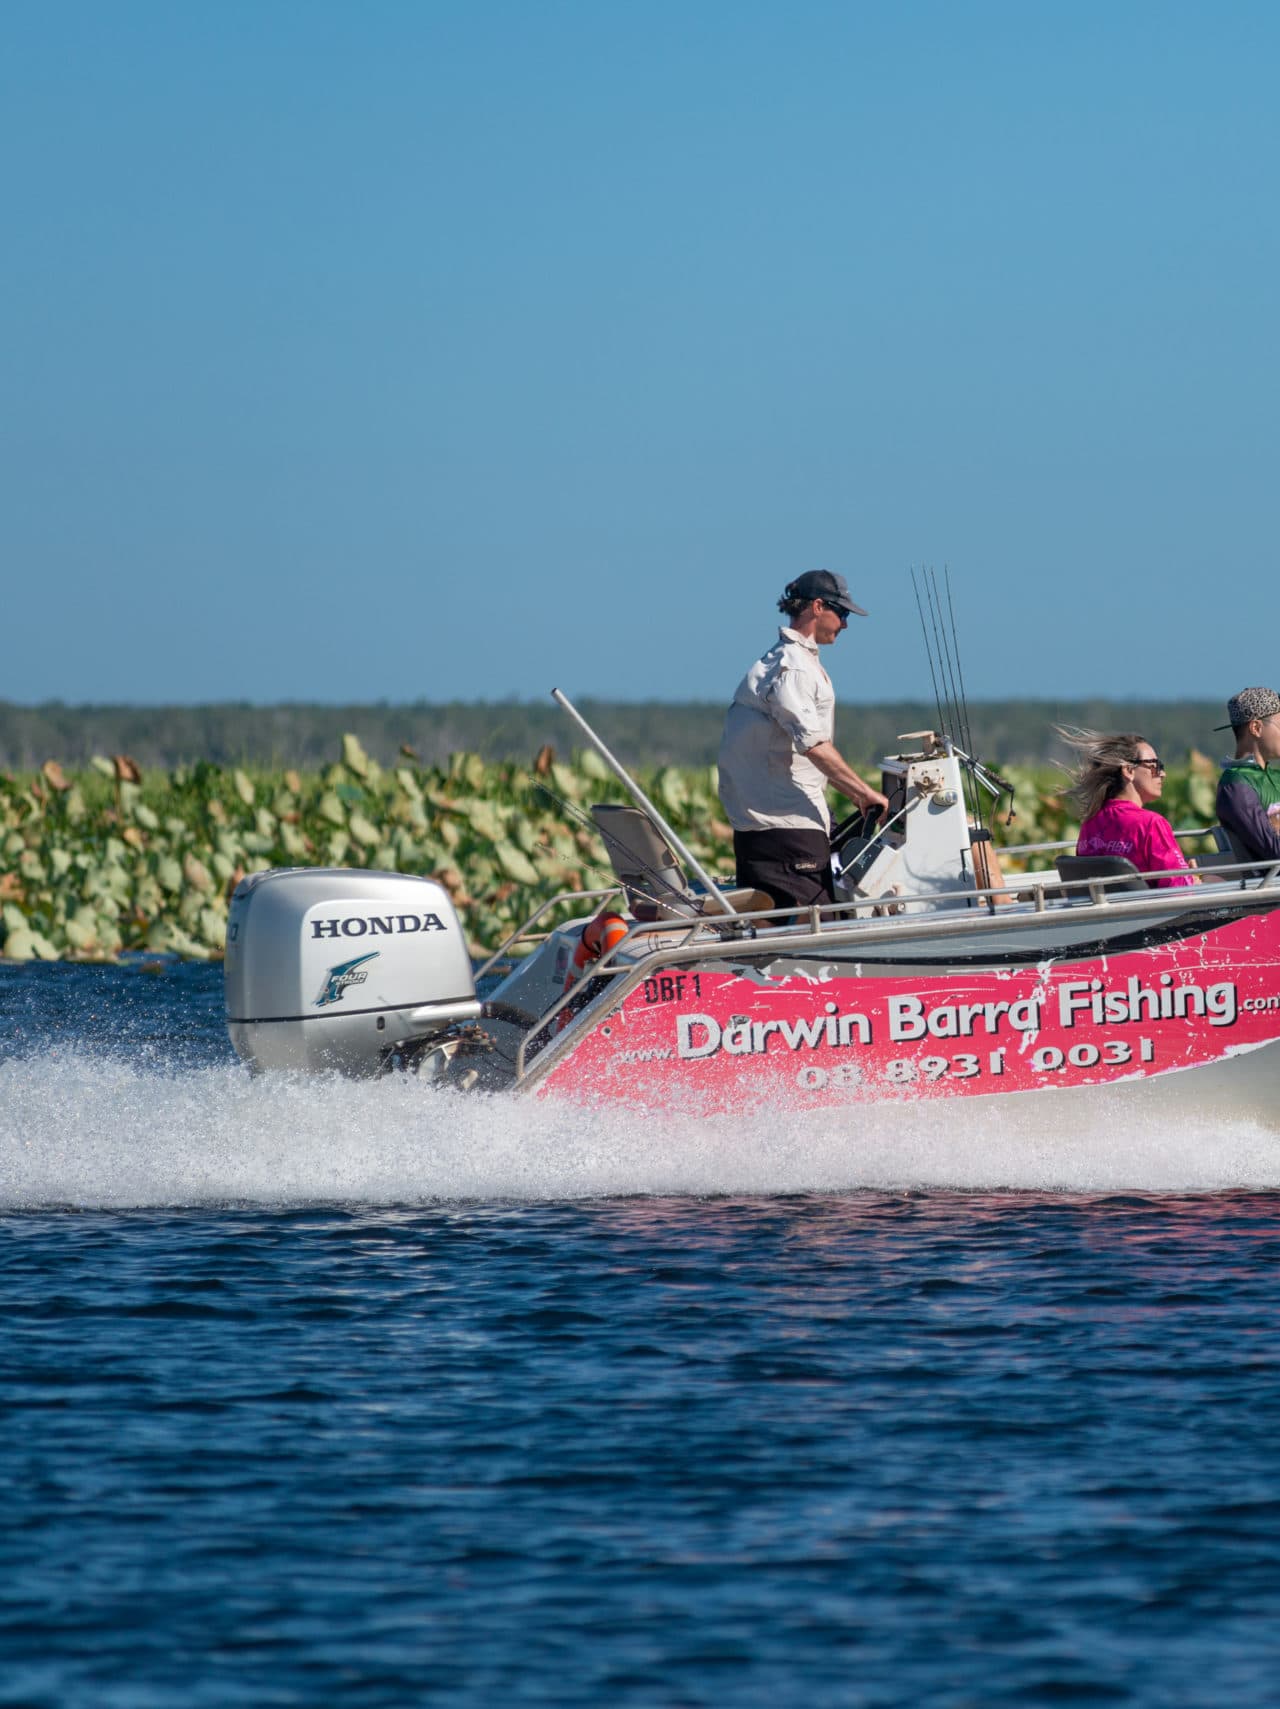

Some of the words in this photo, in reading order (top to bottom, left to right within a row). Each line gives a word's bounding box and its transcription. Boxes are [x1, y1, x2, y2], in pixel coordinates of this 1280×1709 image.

[311, 913, 447, 939] HONDA
[331, 972, 367, 982] FOUR
[644, 975, 687, 1003] DBF
[692, 973, 701, 998] 1
[887, 995, 1041, 1042] Barra
[796, 1063, 864, 1091] 08
[885, 1048, 1005, 1083] 8931
[1032, 1038, 1155, 1072] 0031
